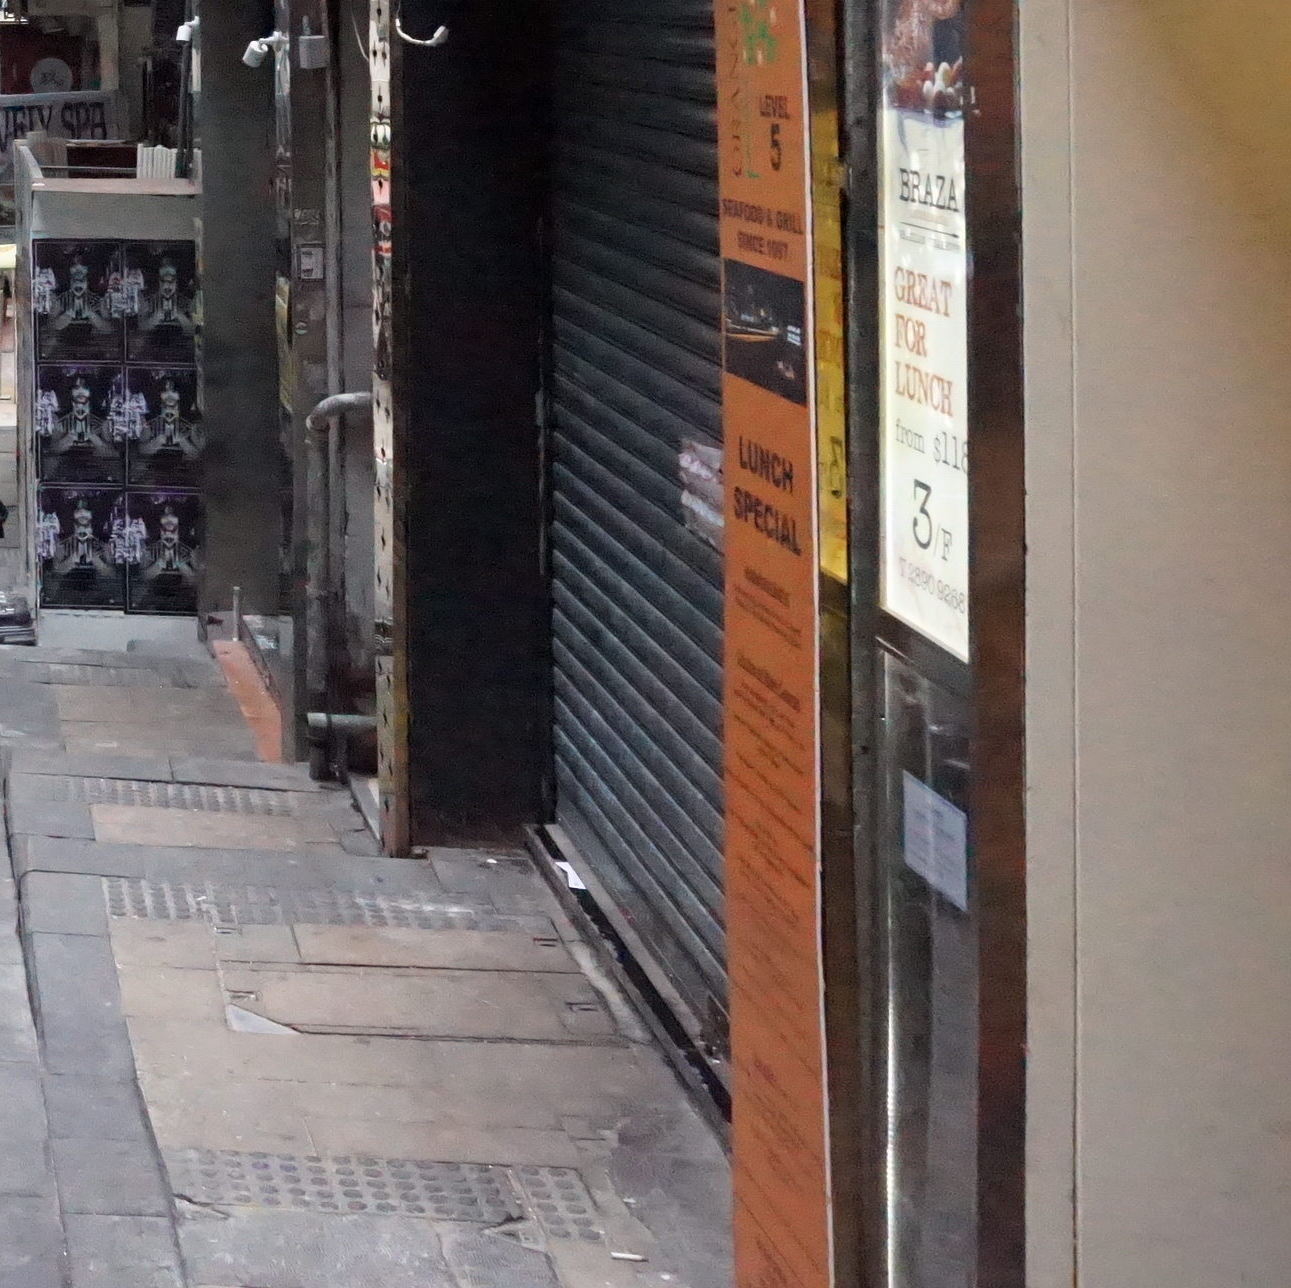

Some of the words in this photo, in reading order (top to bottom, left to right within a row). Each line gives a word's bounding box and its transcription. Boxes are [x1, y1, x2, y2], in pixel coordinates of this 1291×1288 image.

[61, 101, 108, 140] SPA
[770, 123, 782, 172] 5
[899, 168, 959, 213] BRAZA
[894, 266, 952, 317] GREAT
[894, 313, 927, 358] FOR
[894, 361, 953, 418] LUNCH
[895, 418, 926, 454] from
[738, 435, 794, 494] LUNCH
[734, 486, 802, 557] SPECIAL
[912, 478, 952, 562] 3/F
